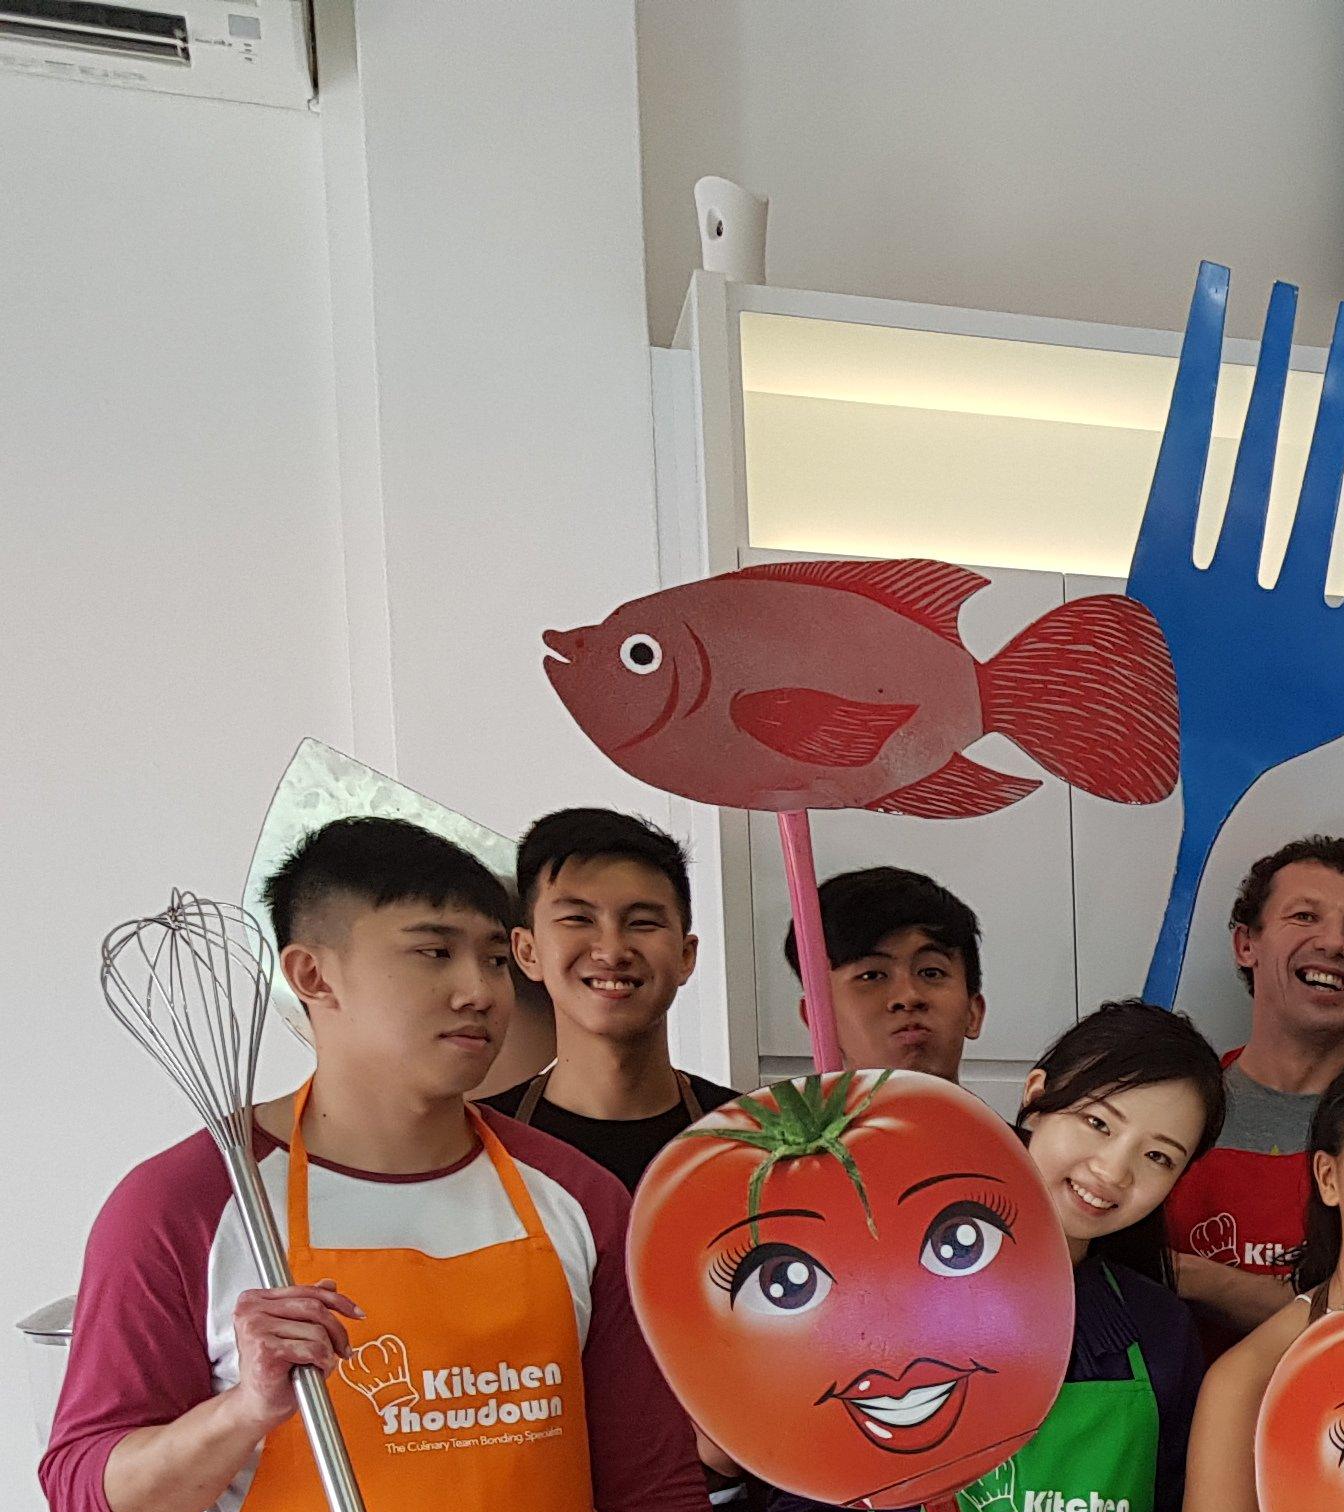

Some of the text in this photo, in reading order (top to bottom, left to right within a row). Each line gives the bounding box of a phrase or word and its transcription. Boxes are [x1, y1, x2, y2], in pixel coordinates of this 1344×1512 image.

[422, 1361, 563, 1401] Kitchen
[382, 1395, 563, 1436] Showdown
[385, 1442, 406, 1454] The
[406, 1439, 450, 1453] Culinary
[450, 1437, 479, 1449] Team
[480, 1432, 524, 1447] Bonding
